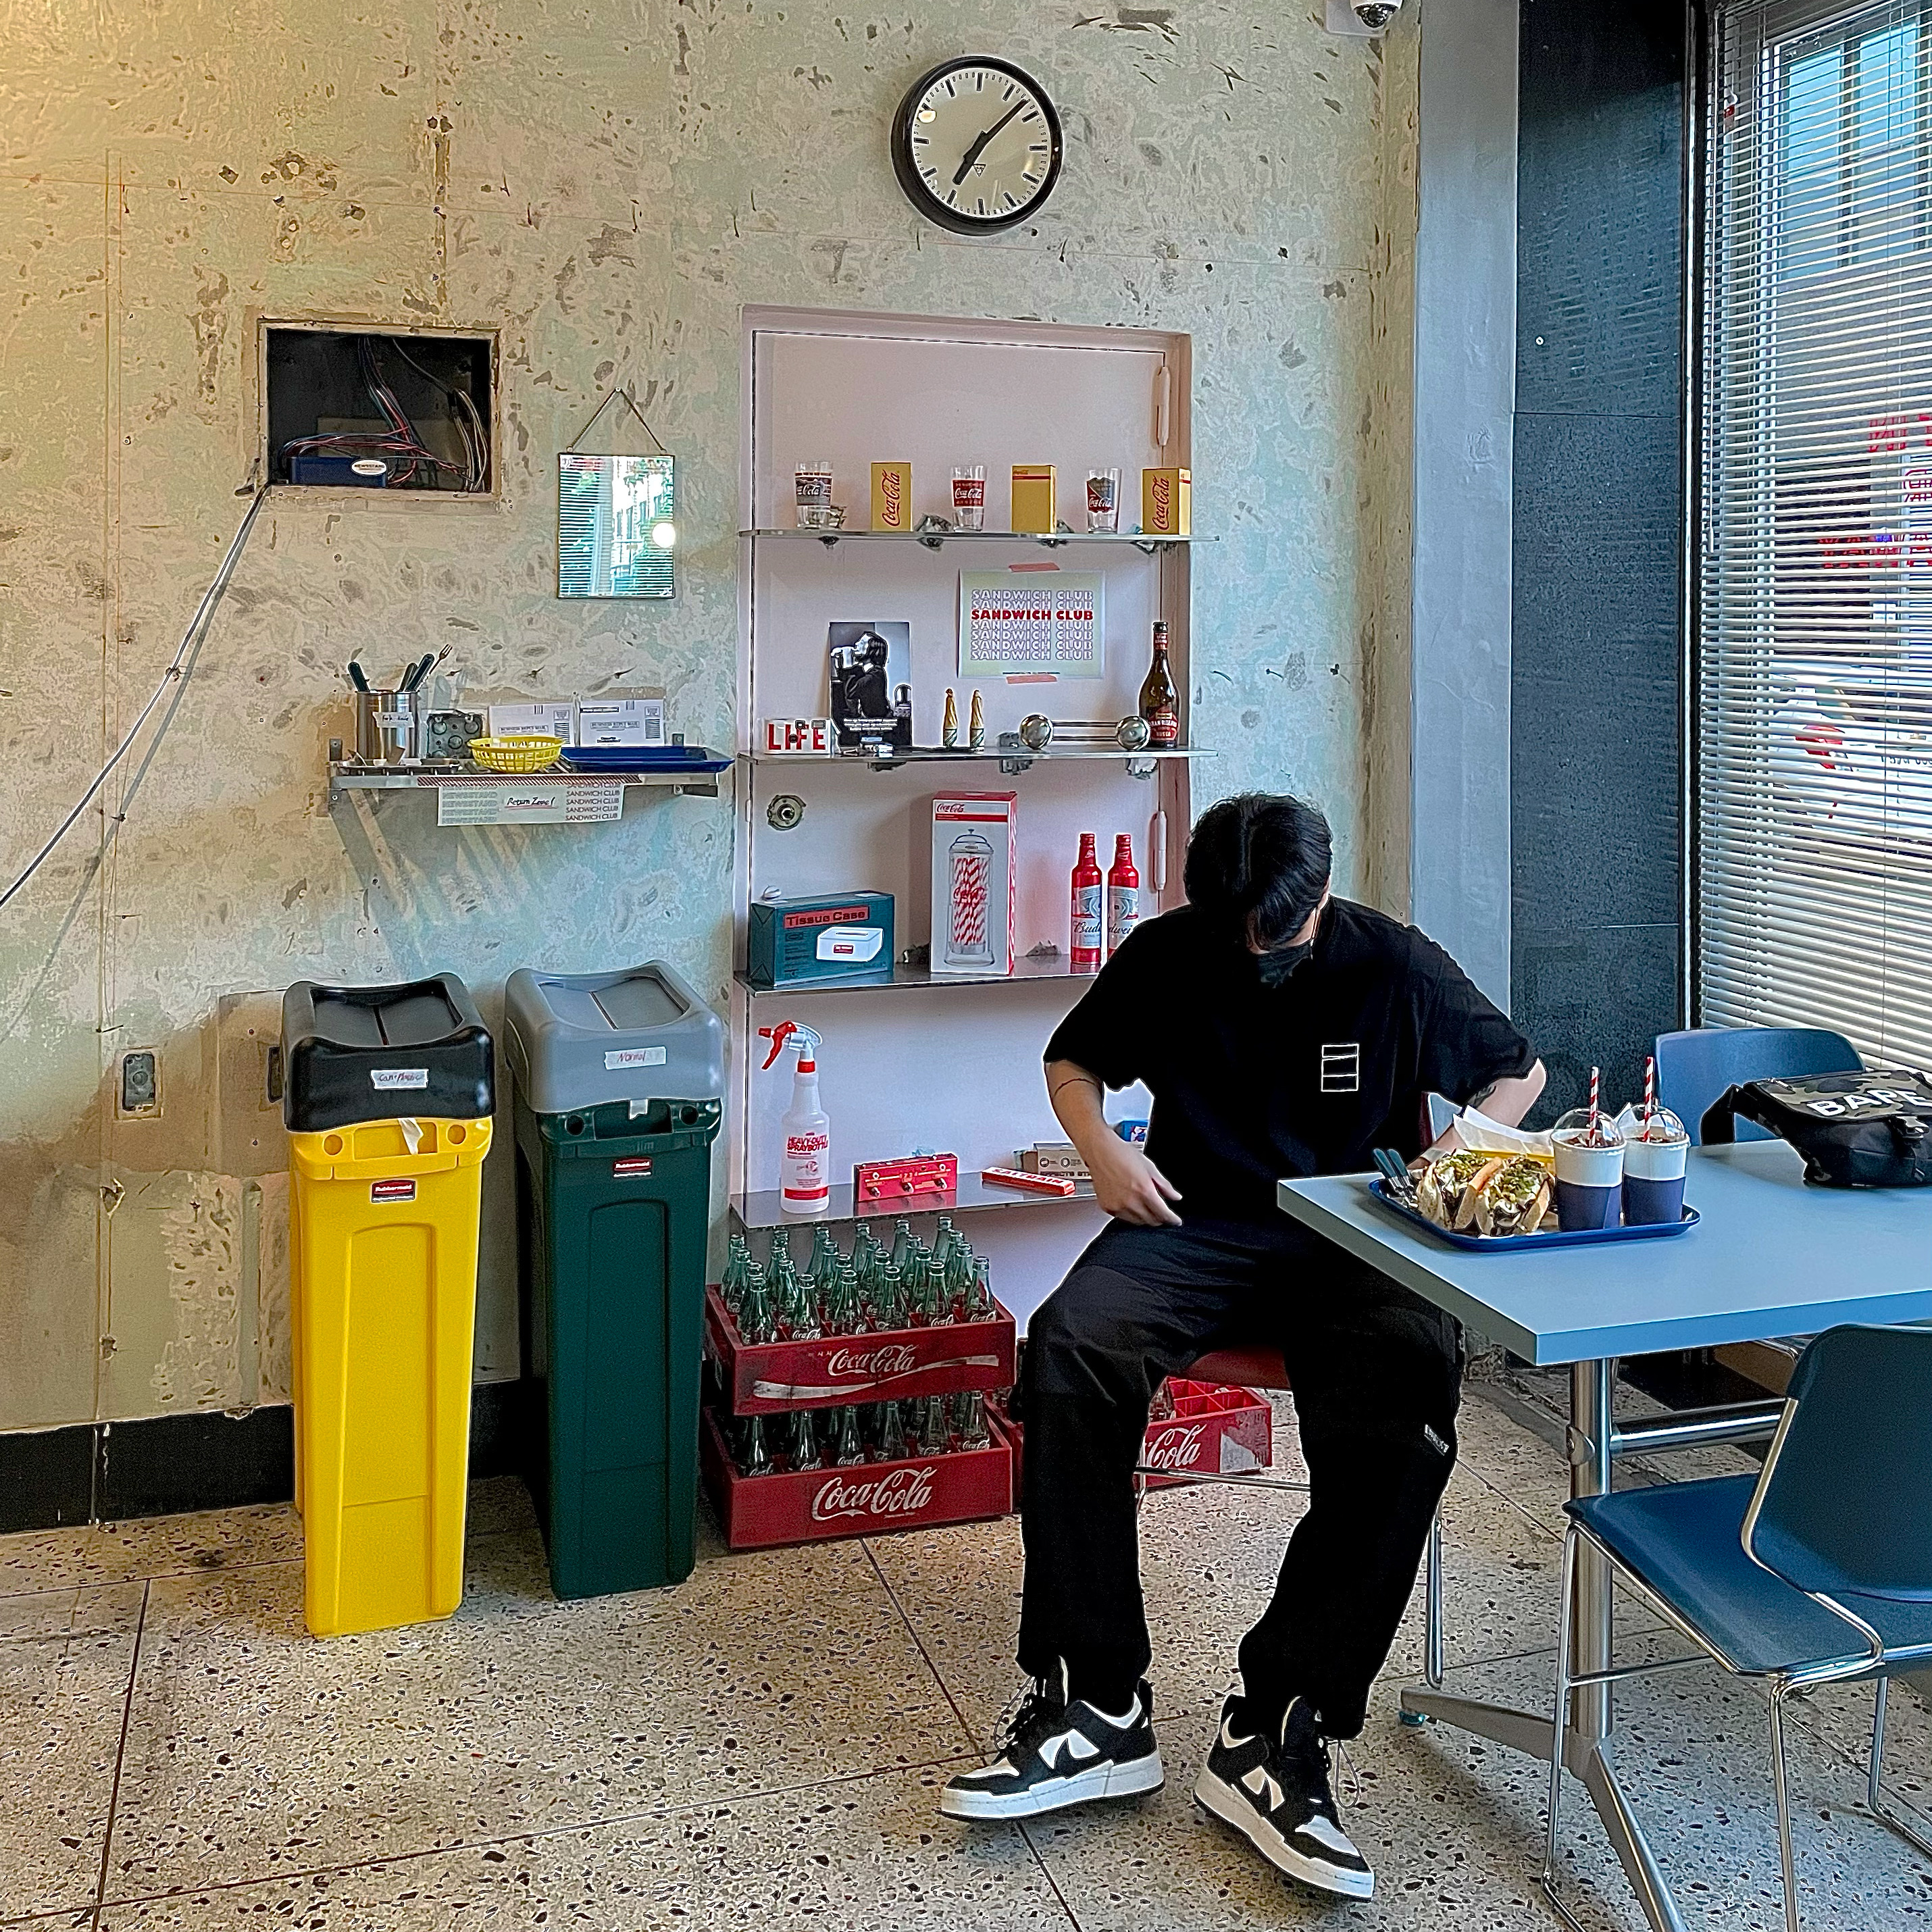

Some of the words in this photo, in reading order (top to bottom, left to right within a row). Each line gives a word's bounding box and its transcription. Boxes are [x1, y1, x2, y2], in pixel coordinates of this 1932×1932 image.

[971, 589, 1052, 601] SANDWICH
[1056, 590, 1093, 601] CLUB
[971, 600, 1052, 610] SANDWICH
[1056, 601, 1093, 610] CLUB
[971, 609, 1052, 620] SANDWICH
[1056, 610, 1093, 620] CLUB
[971, 619, 1052, 630] SANDWICH
[1056, 620, 1093, 630] CLUB
[971, 630, 1051, 640] SANDWICH
[1055, 630, 1093, 640] CLUB
[971, 640, 1051, 651] SANDWICH
[1055, 640, 1093, 651] CLUB
[971, 650, 1051, 661] SANDWICH
[1055, 651, 1093, 661] CLUB
[768, 723, 825, 750] LIFE
[786, 915, 830, 926] Tissue
[833, 911, 865, 921] Case
[617, 1050, 646, 1063] Normal
[992, 1169, 1065, 1184] SALTRAIN
[828, 1344, 920, 1376] Coca-Cola
[812, 1467, 938, 1521] Coca-Cola
